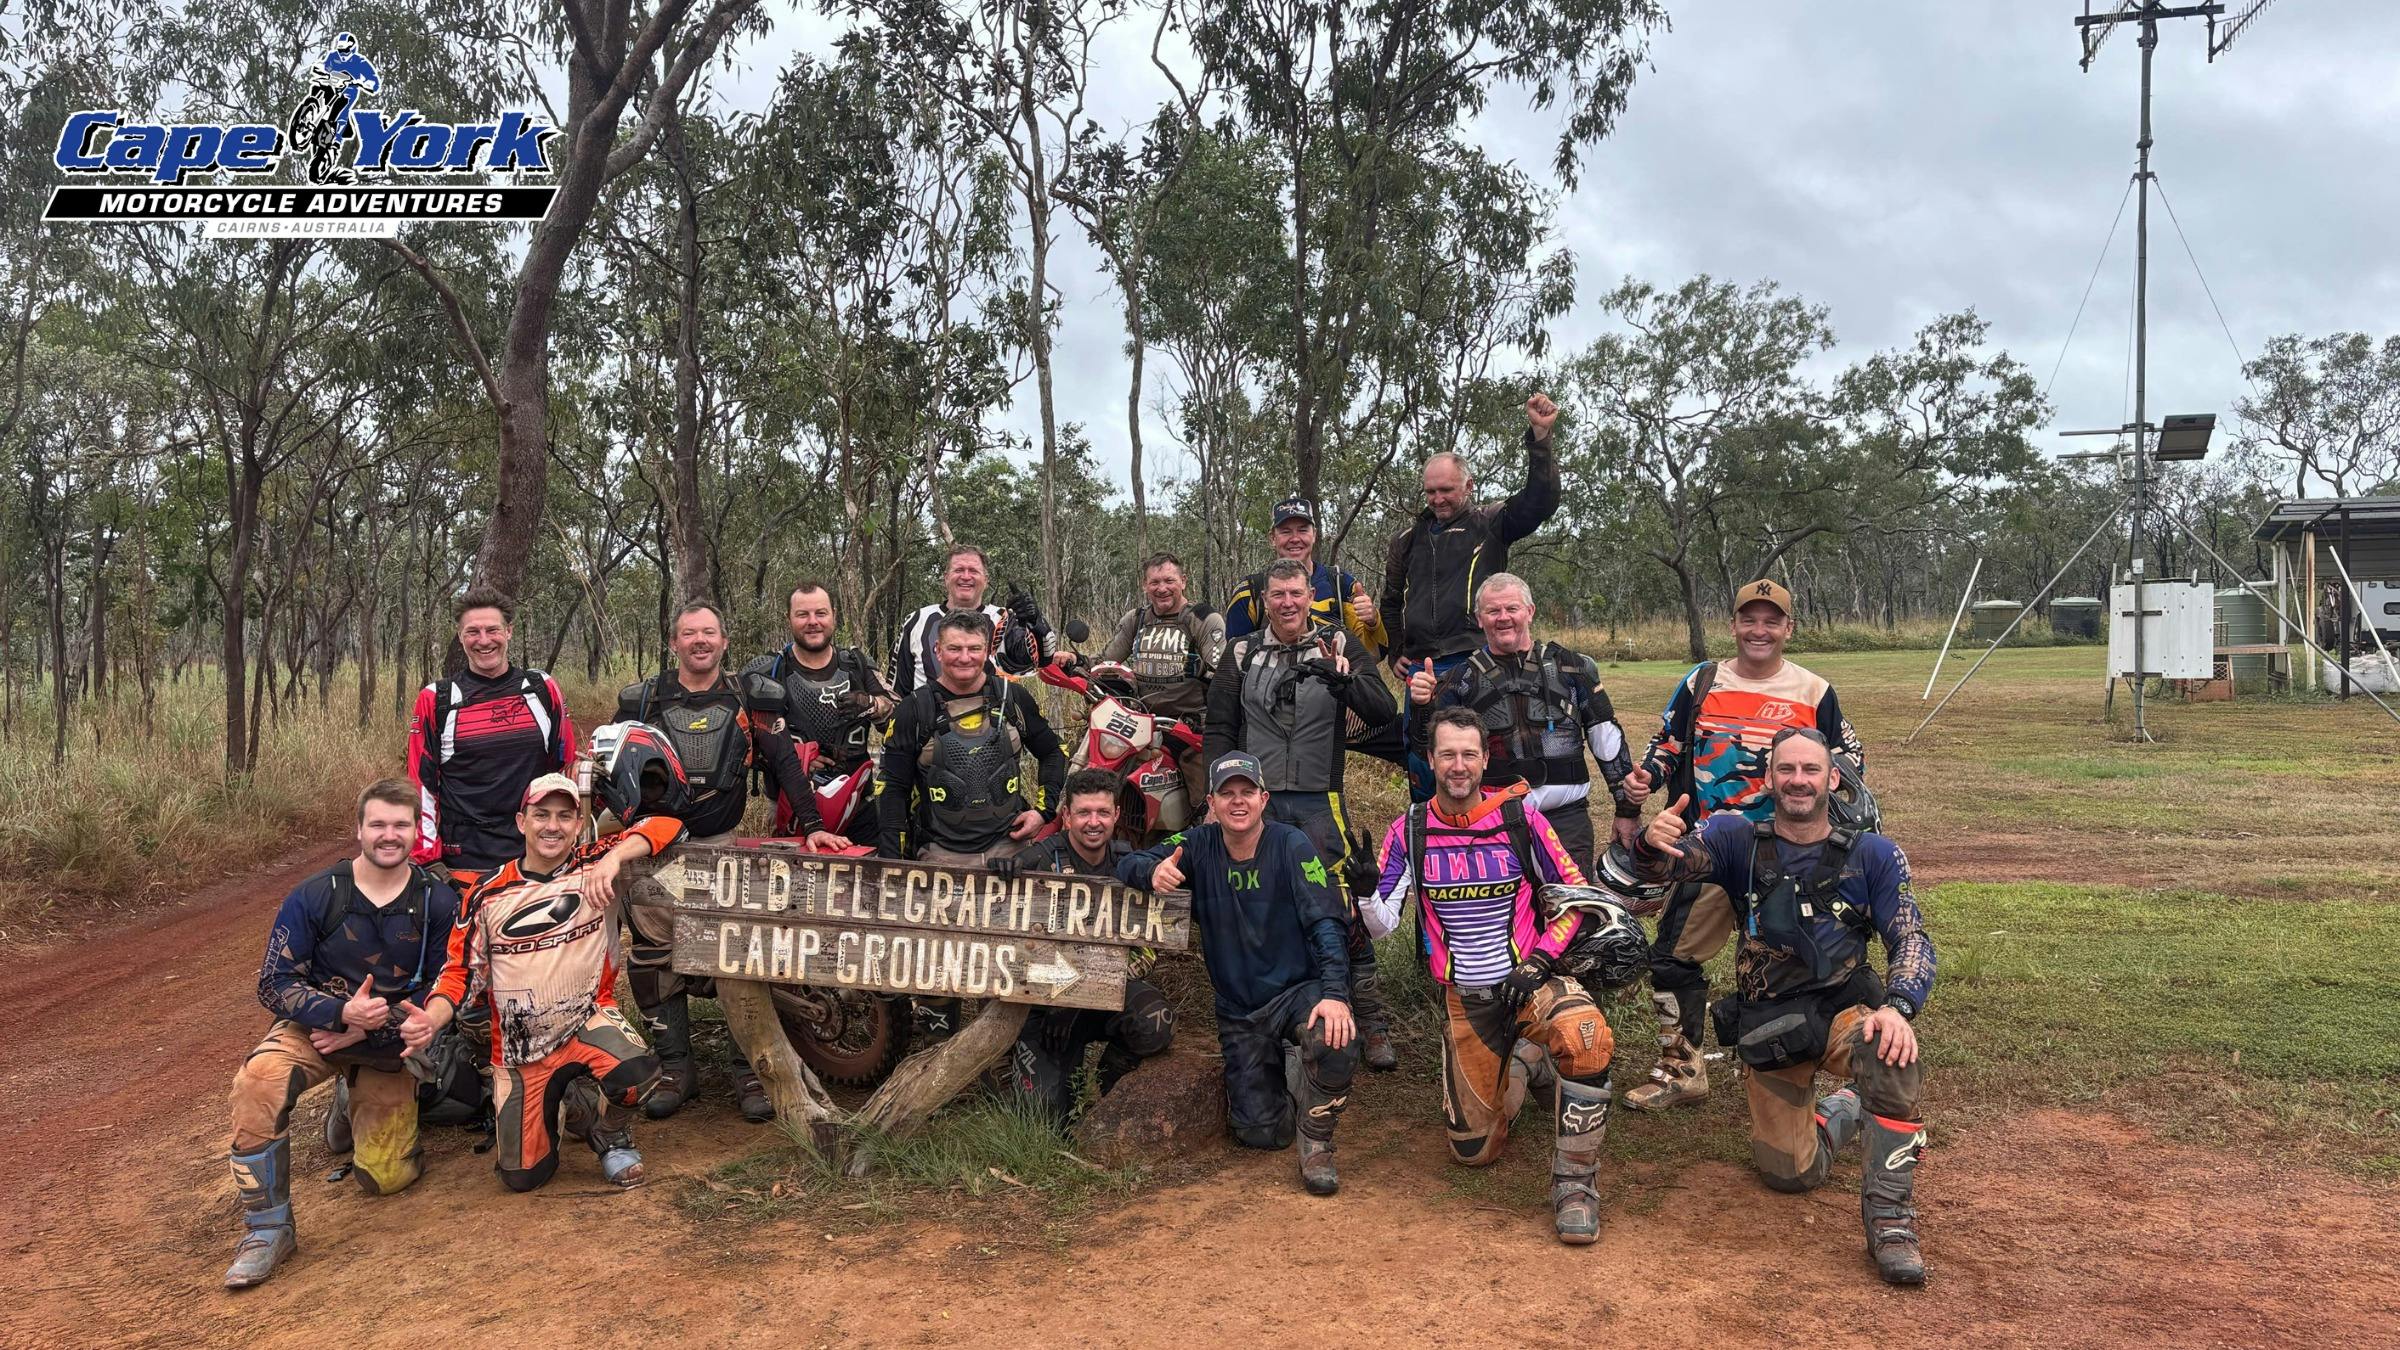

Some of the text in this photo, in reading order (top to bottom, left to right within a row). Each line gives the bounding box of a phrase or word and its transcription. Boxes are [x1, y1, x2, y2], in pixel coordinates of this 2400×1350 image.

[1755, 582, 1772, 596] NY
[1105, 718, 1137, 740] 28
[715, 855, 791, 912] OLD
[803, 861, 1034, 932] TELEGRAPH
[1045, 880, 1165, 943] TRACK
[1428, 882, 1515, 901] RACING CO
[537, 917, 604, 950] SPORT
[1551, 909, 1577, 943] UNI
[719, 921, 821, 980] CAMP
[836, 931, 1017, 997] GROUNDS
[1146, 1007, 1173, 1033] 70
